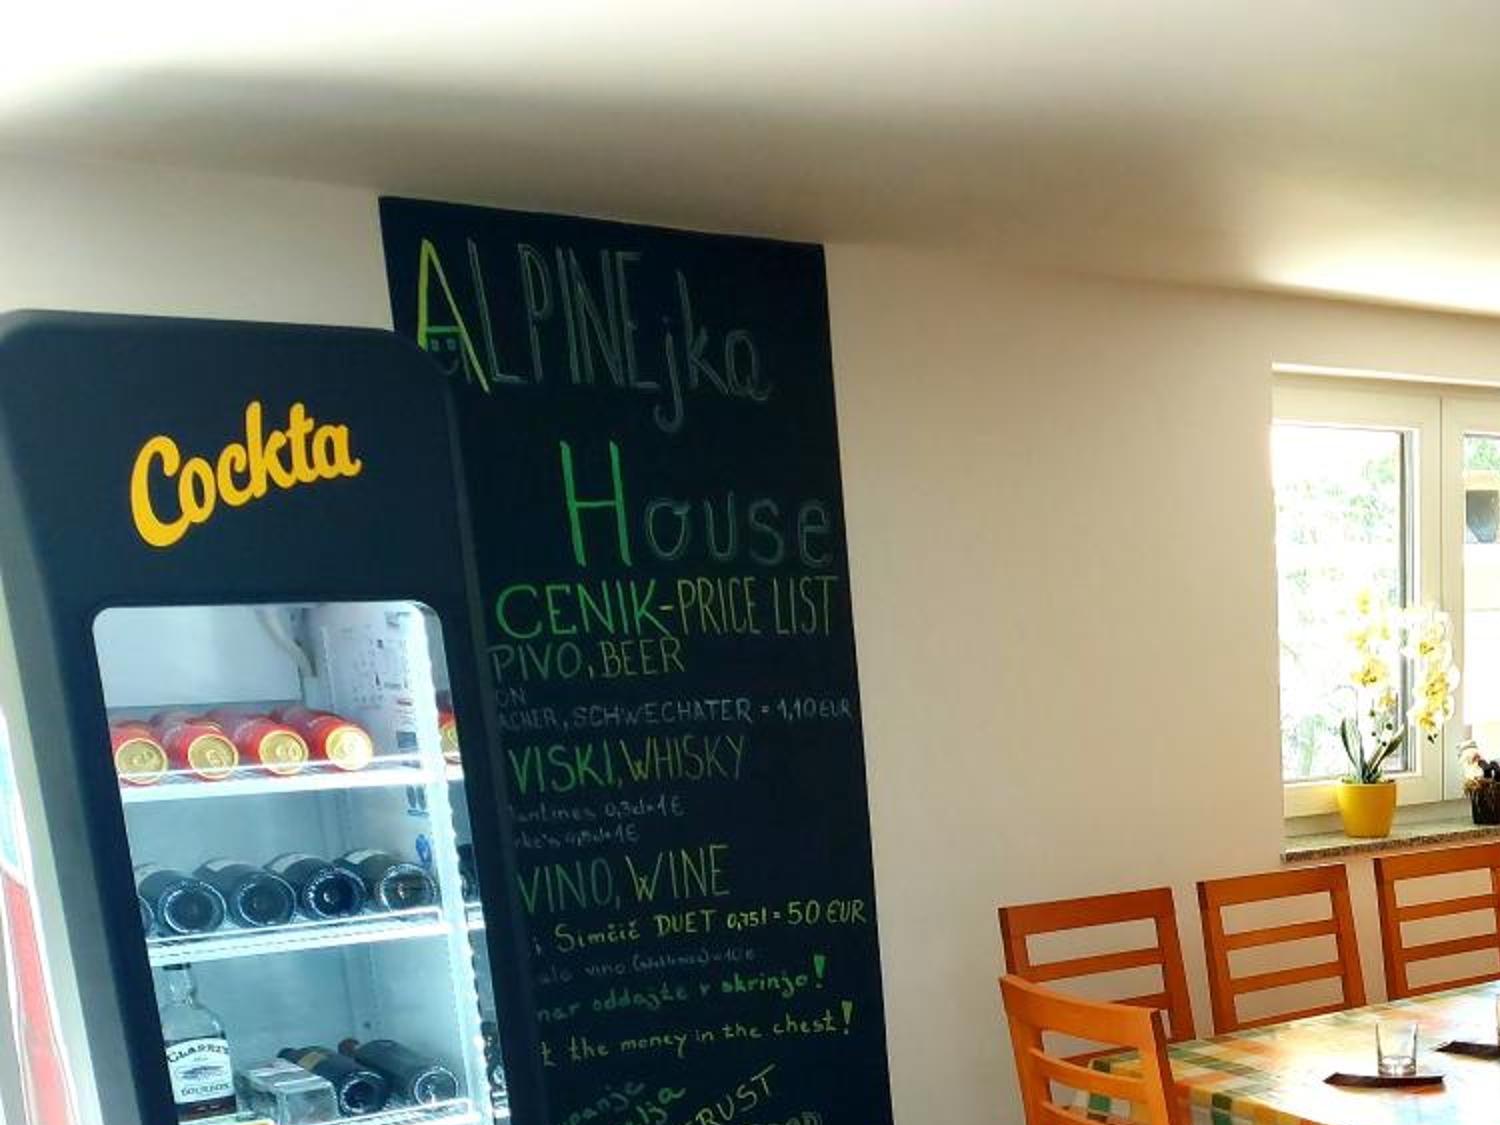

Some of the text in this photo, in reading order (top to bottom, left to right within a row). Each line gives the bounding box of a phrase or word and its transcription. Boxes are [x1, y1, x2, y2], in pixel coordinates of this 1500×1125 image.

[131, 400, 363, 548] Cockta
[559, 439, 834, 569] House
[772, 575, 839, 637] LIST
[599, 636, 688, 678] BEER
[618, 735, 746, 782] WHISKY
[625, 843, 730, 903] WINE
[653, 908, 718, 939] DUET
[785, 899, 820, 927] 50
[568, 1034, 610, 1064] the
[619, 1030, 688, 1059] money
